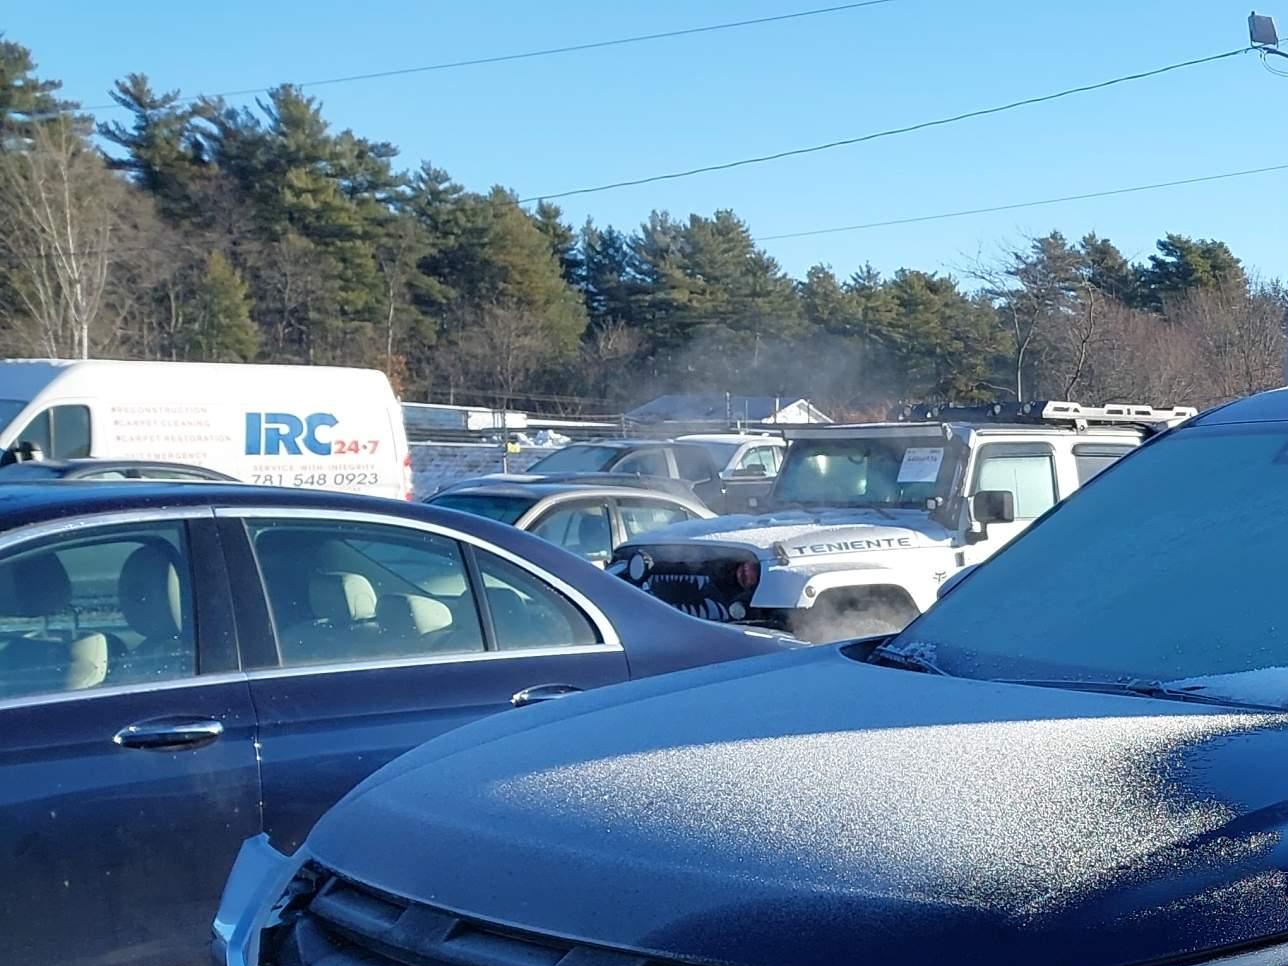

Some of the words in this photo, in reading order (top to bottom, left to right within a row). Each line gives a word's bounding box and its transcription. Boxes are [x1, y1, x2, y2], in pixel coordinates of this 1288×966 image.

[245, 412, 339, 456] IRC
[251, 474, 283, 486] 781
[293, 473, 327, 487] 548
[334, 473, 379, 486] 0923
[792, 537, 912, 555] TENIENTE
